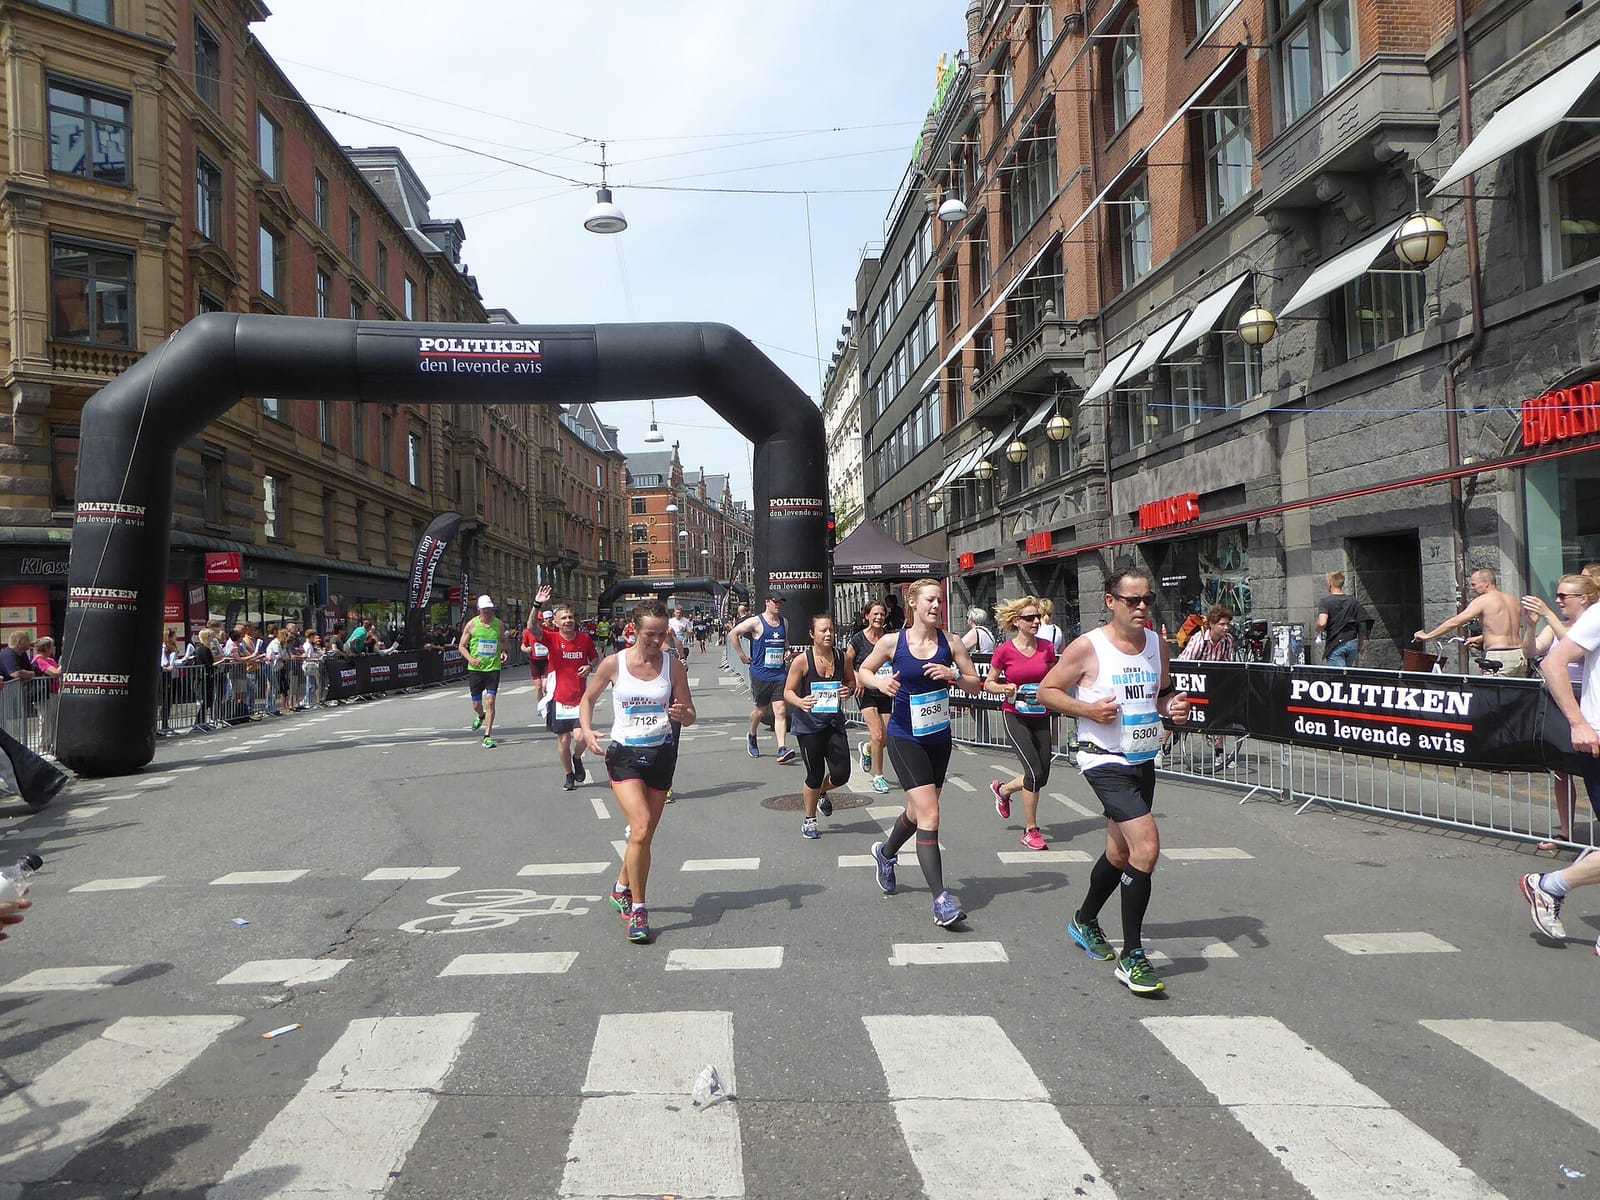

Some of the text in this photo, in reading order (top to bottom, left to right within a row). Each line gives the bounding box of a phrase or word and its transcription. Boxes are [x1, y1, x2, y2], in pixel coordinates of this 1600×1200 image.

[420, 338, 540, 353] POLITIKEN
[420, 358, 542, 374] den levende avis
[78, 502, 146, 514] POLITIKEN
[770, 498, 823, 507] POLITIKEN
[76, 514, 86, 523] den
[88, 515, 122, 524] levende
[420, 536, 432, 552] den
[412, 554, 428, 588] levende
[420, 540, 447, 608] POLITIKEN
[768, 572, 823, 580] POLITIKEN
[70, 587, 138, 599] POLITIKEN
[80, 600, 114, 609] levende
[118, 602, 137, 610] avis
[62, 673, 130, 683] POLITIKEN
[72, 686, 106, 695] levende
[949, 686, 966, 698] den
[1125, 685, 1144, 700] NOT
[1290, 680, 1472, 716] POLITIKEN
[920, 704, 942, 716] 2638
[634, 716, 658, 726] 7126
[1132, 727, 1158, 739] 6300
[1294, 716, 1465, 753] den levende avis
